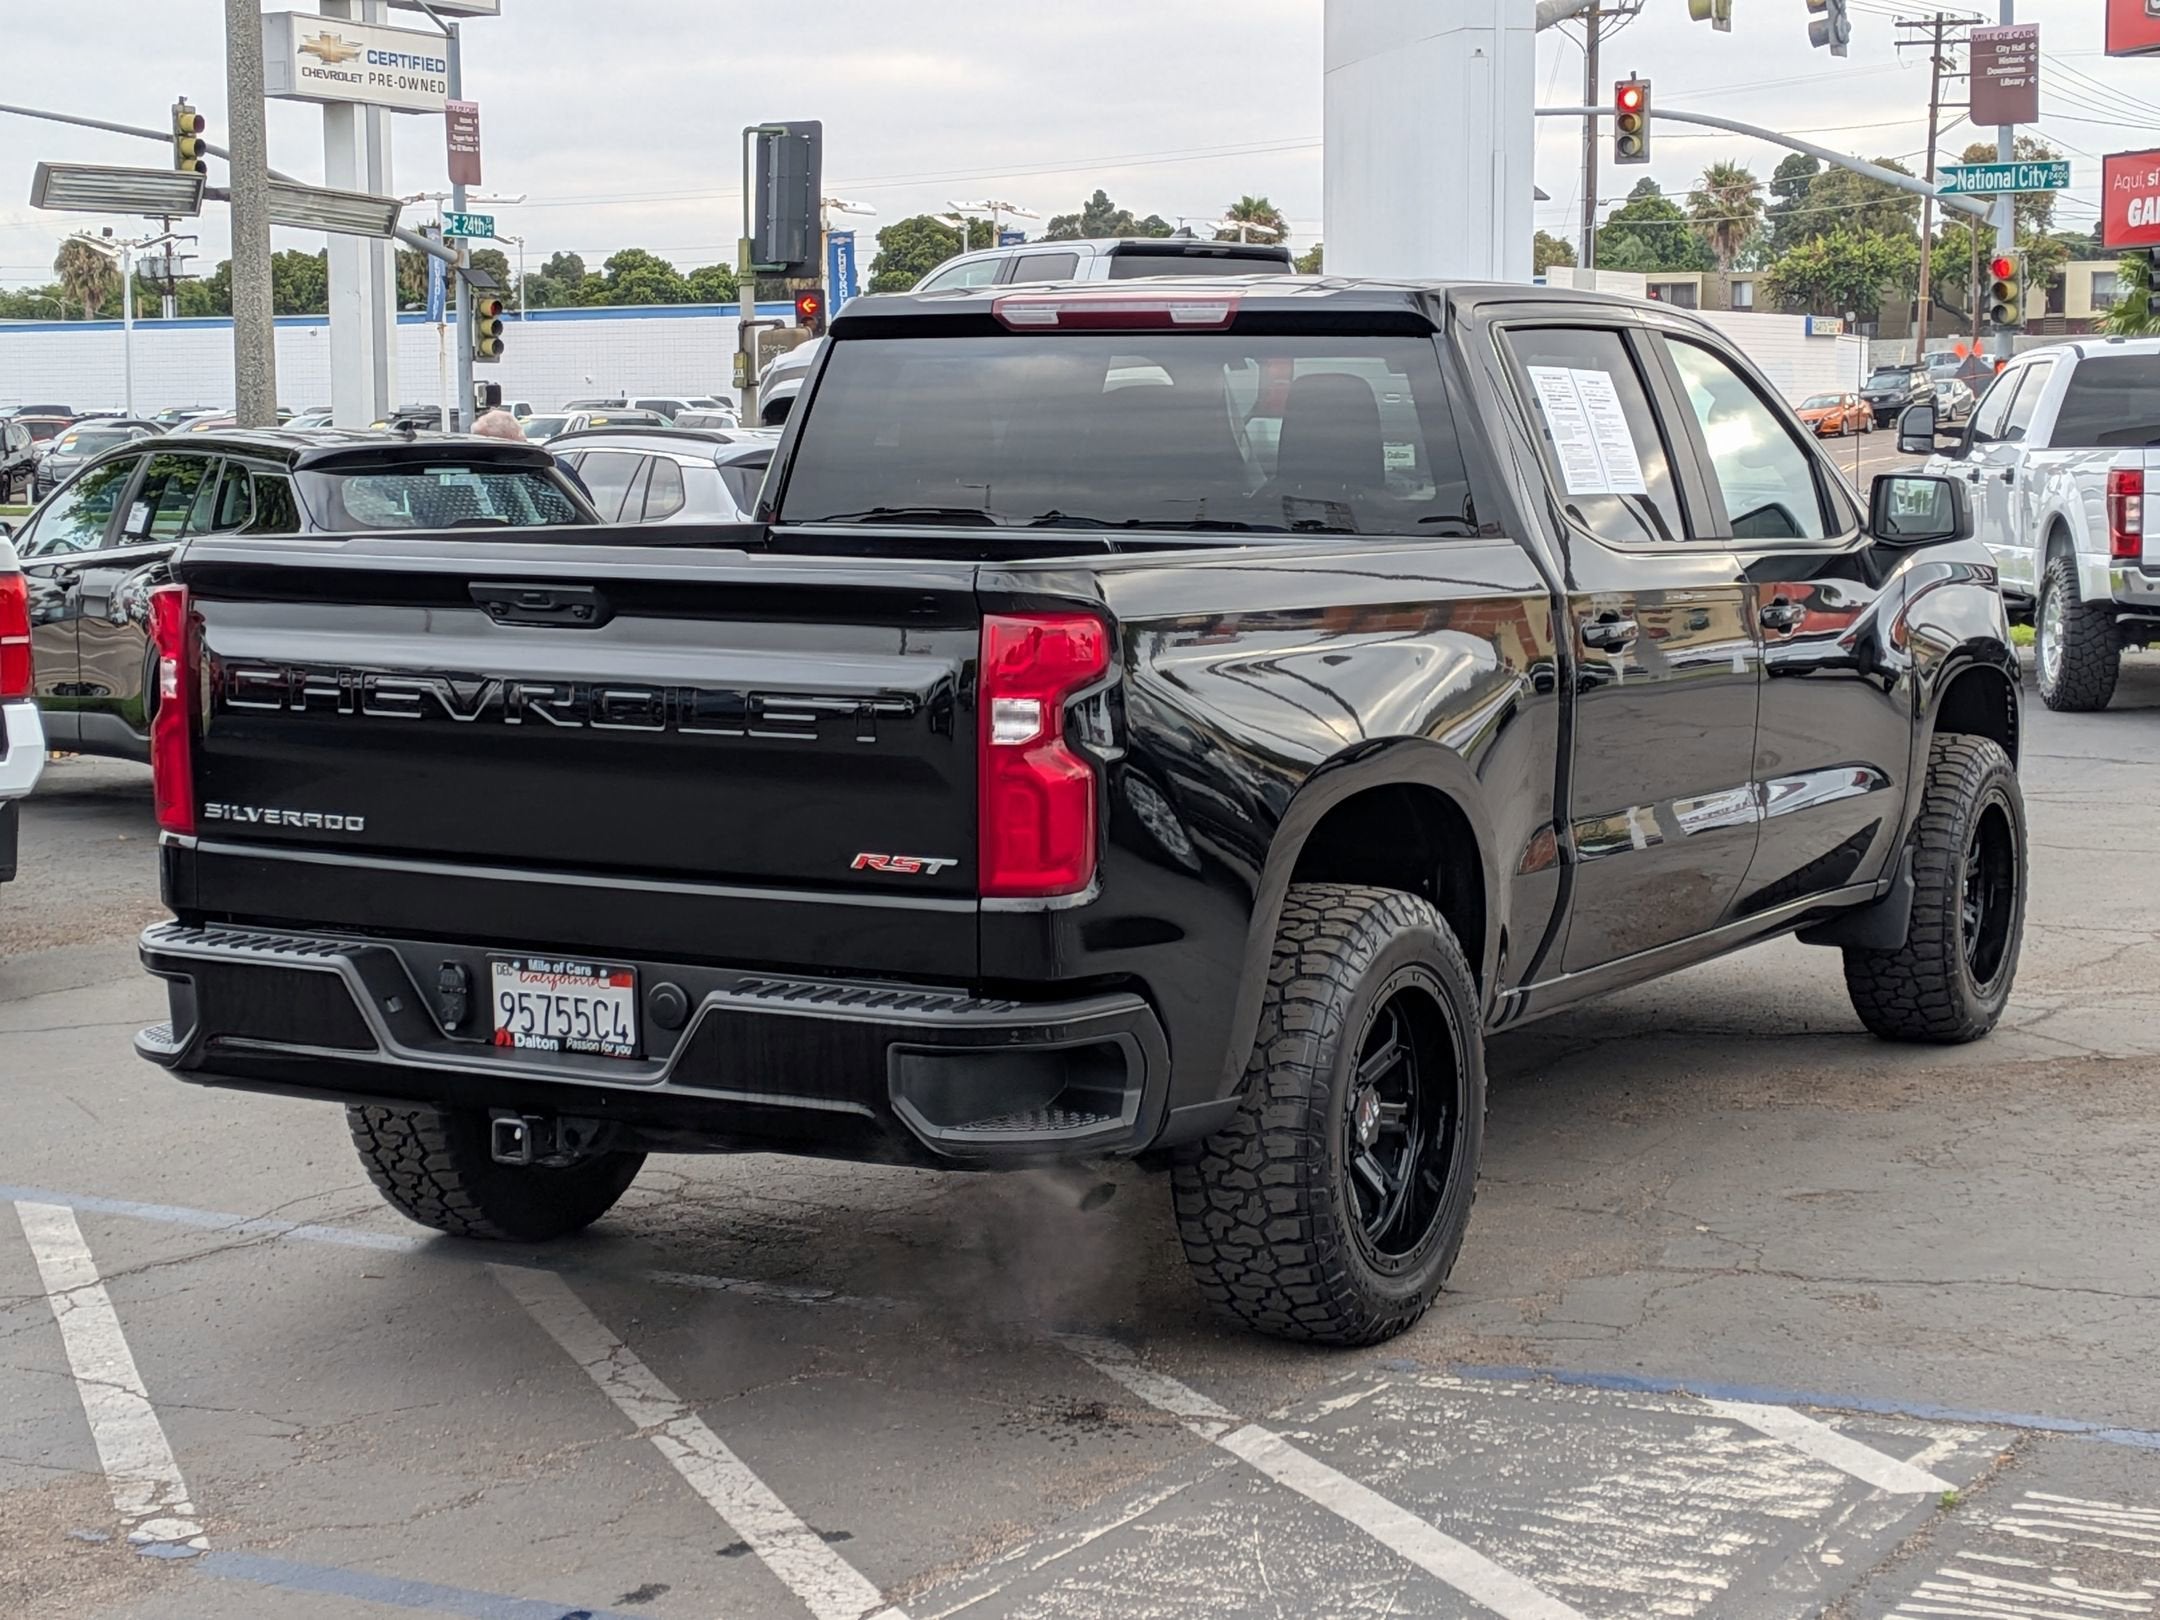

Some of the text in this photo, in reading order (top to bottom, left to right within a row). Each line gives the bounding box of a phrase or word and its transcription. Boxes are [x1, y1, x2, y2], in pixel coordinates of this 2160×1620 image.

[1972, 29, 2036, 41] MILE OF CARS
[1995, 42, 2026, 54] City Hall
[367, 49, 446, 73] CERTIFIED
[301, 66, 446, 94] CHEVROLET PRE-OWNED
[2000, 77, 2026, 87] Library
[1957, 165, 2049, 190] National City
[2048, 172, 2068, 180] 2400
[452, 215, 485, 236] E 24th
[224, 664, 915, 742] CHEVROLET
[204, 802, 365, 831] SILVERADO
[850, 853, 959, 875] RST
[528, 958, 592, 976] Mile of Cars
[519, 970, 610, 992] California
[500, 991, 629, 1044] 95755C4
[515, 1033, 633, 1056] Dalton Passion for you
